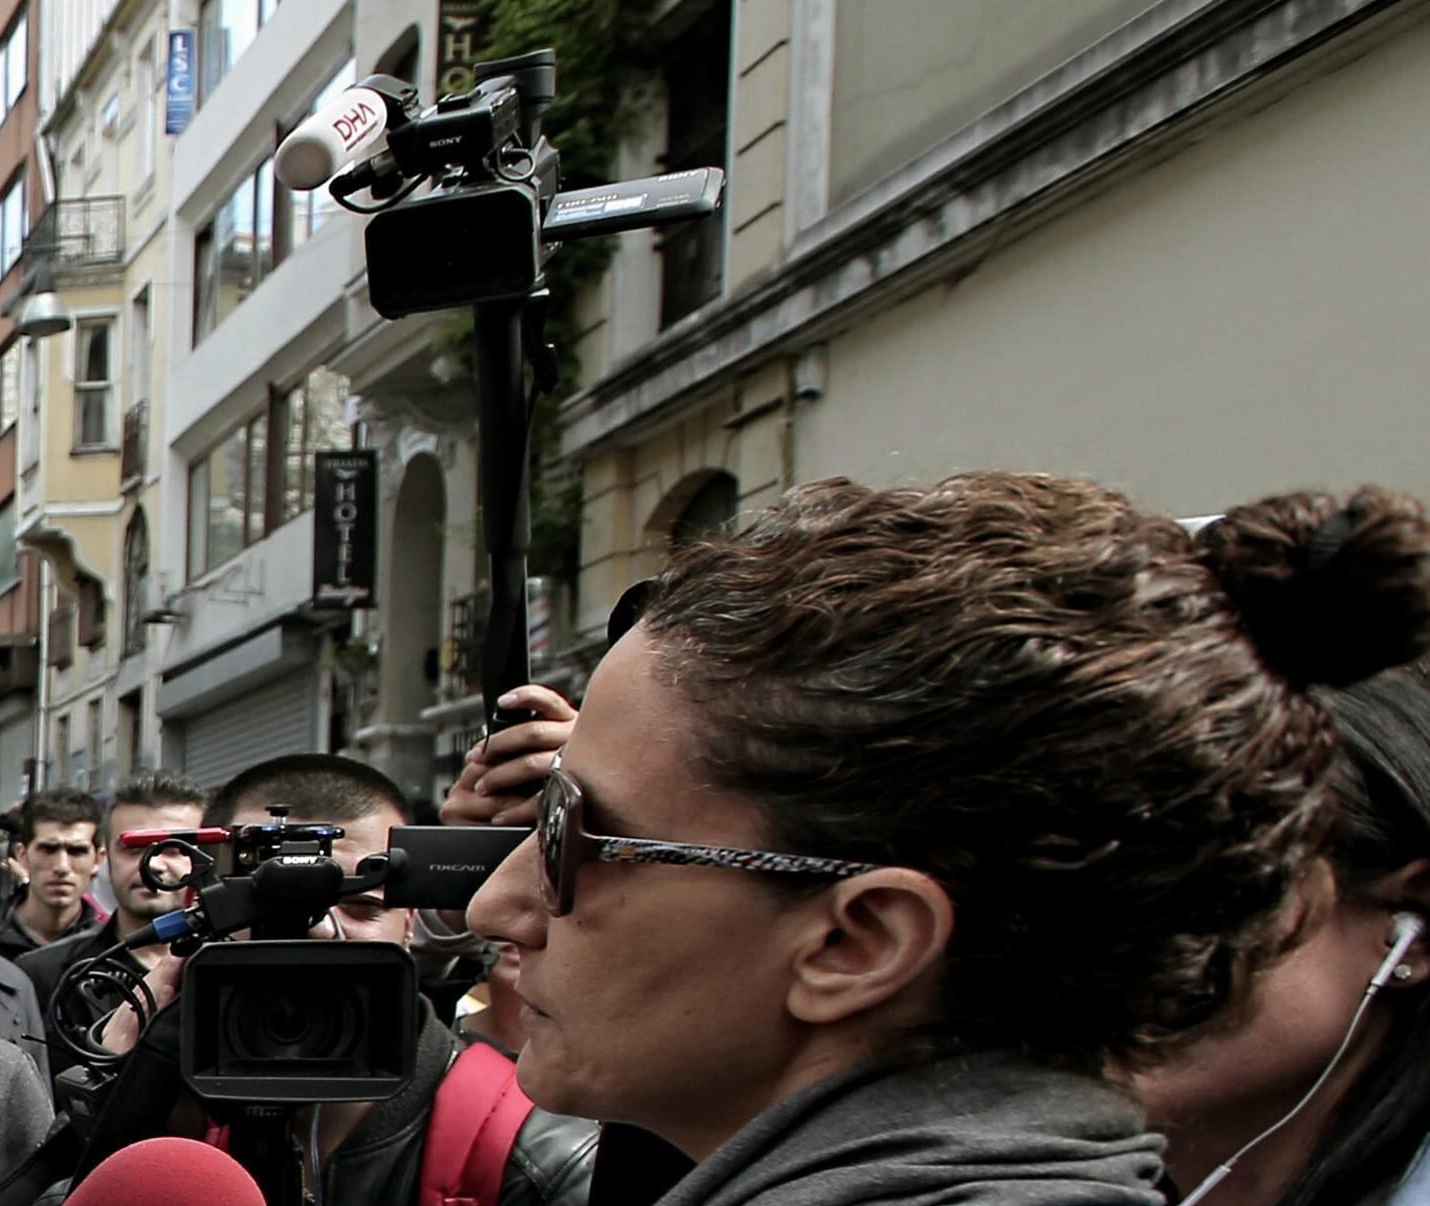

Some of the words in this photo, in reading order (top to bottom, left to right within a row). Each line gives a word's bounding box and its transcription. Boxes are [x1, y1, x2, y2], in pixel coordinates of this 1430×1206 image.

[429, 135, 463, 149] SONY
[333, 482, 357, 584] HOTEL
[282, 855, 318, 865] SONY
